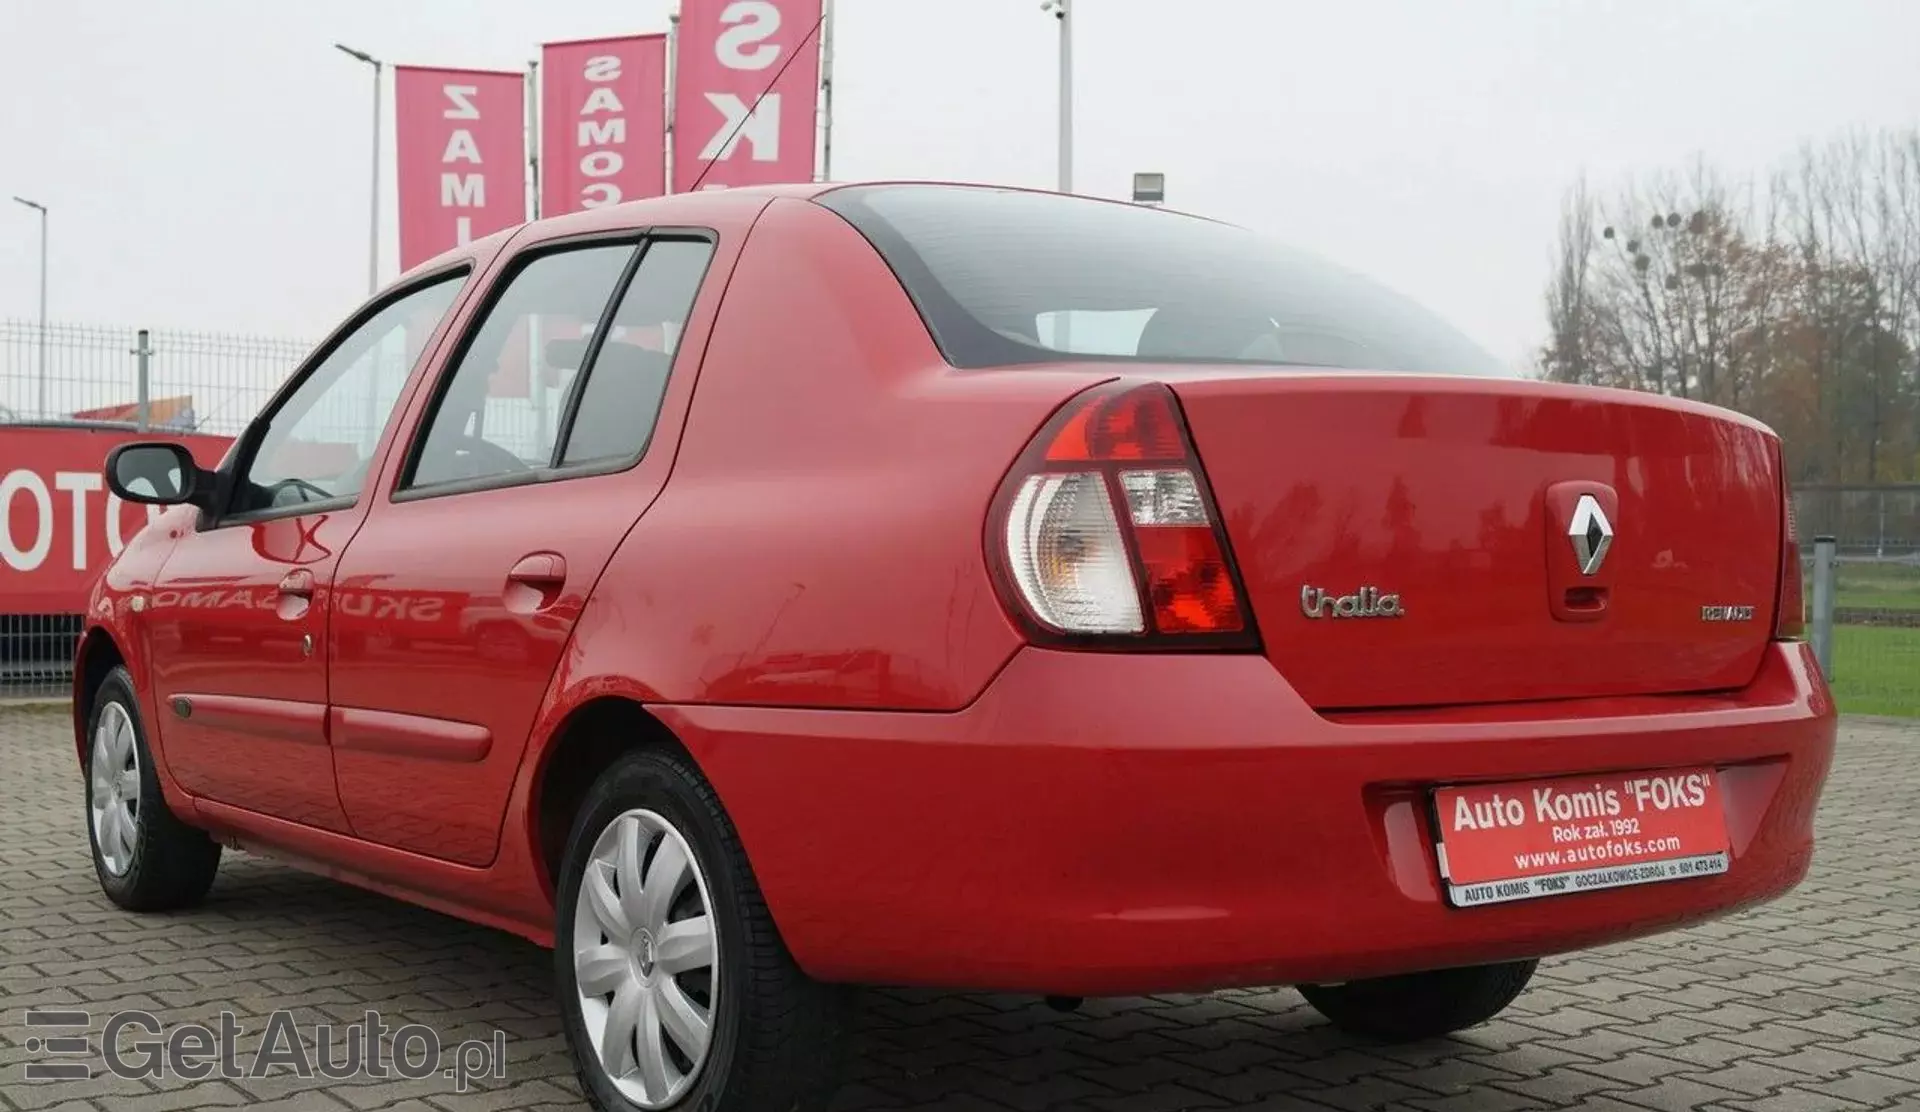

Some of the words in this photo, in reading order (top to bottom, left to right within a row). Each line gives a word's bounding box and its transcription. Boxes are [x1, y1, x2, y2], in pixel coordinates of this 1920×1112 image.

[1453, 795, 1525, 832] Auto
[1532, 783, 1622, 823] Komis
[1624, 773, 1711, 812] "FOKS"
[1552, 823, 1582, 844] Rok
[1583, 820, 1609, 840] zał.
[1609, 817, 1641, 836] 1992
[1514, 835, 1681, 869] www.autofoks.com
[1464, 887, 1494, 903] AUTO
[1496, 881, 1530, 897] KOMIS
